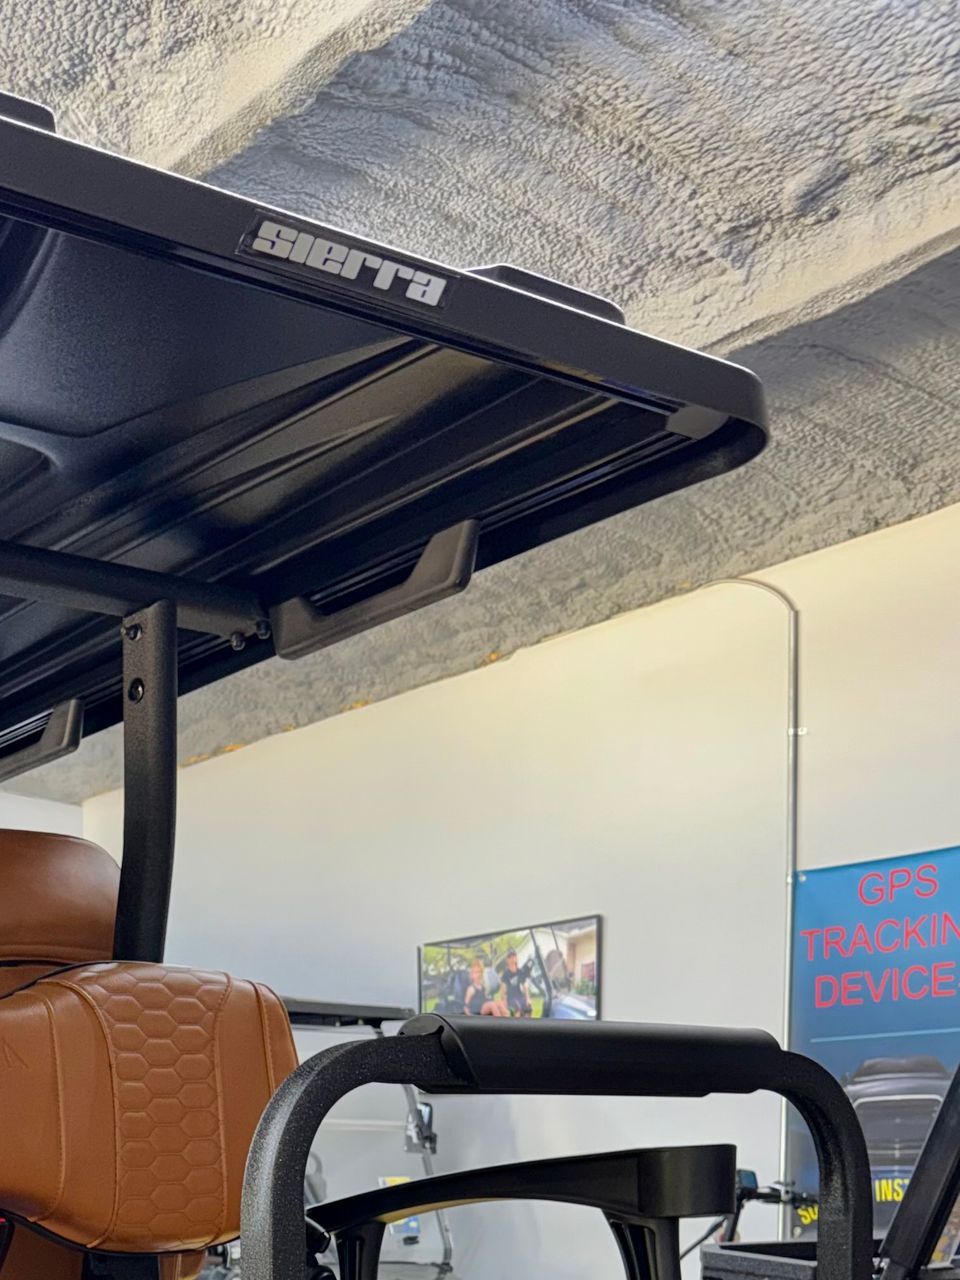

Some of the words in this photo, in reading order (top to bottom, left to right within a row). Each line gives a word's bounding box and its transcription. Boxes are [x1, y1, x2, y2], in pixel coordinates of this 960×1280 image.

[252, 220, 447, 307] sierra
[858, 864, 939, 906] GPS
[814, 961, 960, 1008] DEVICE
